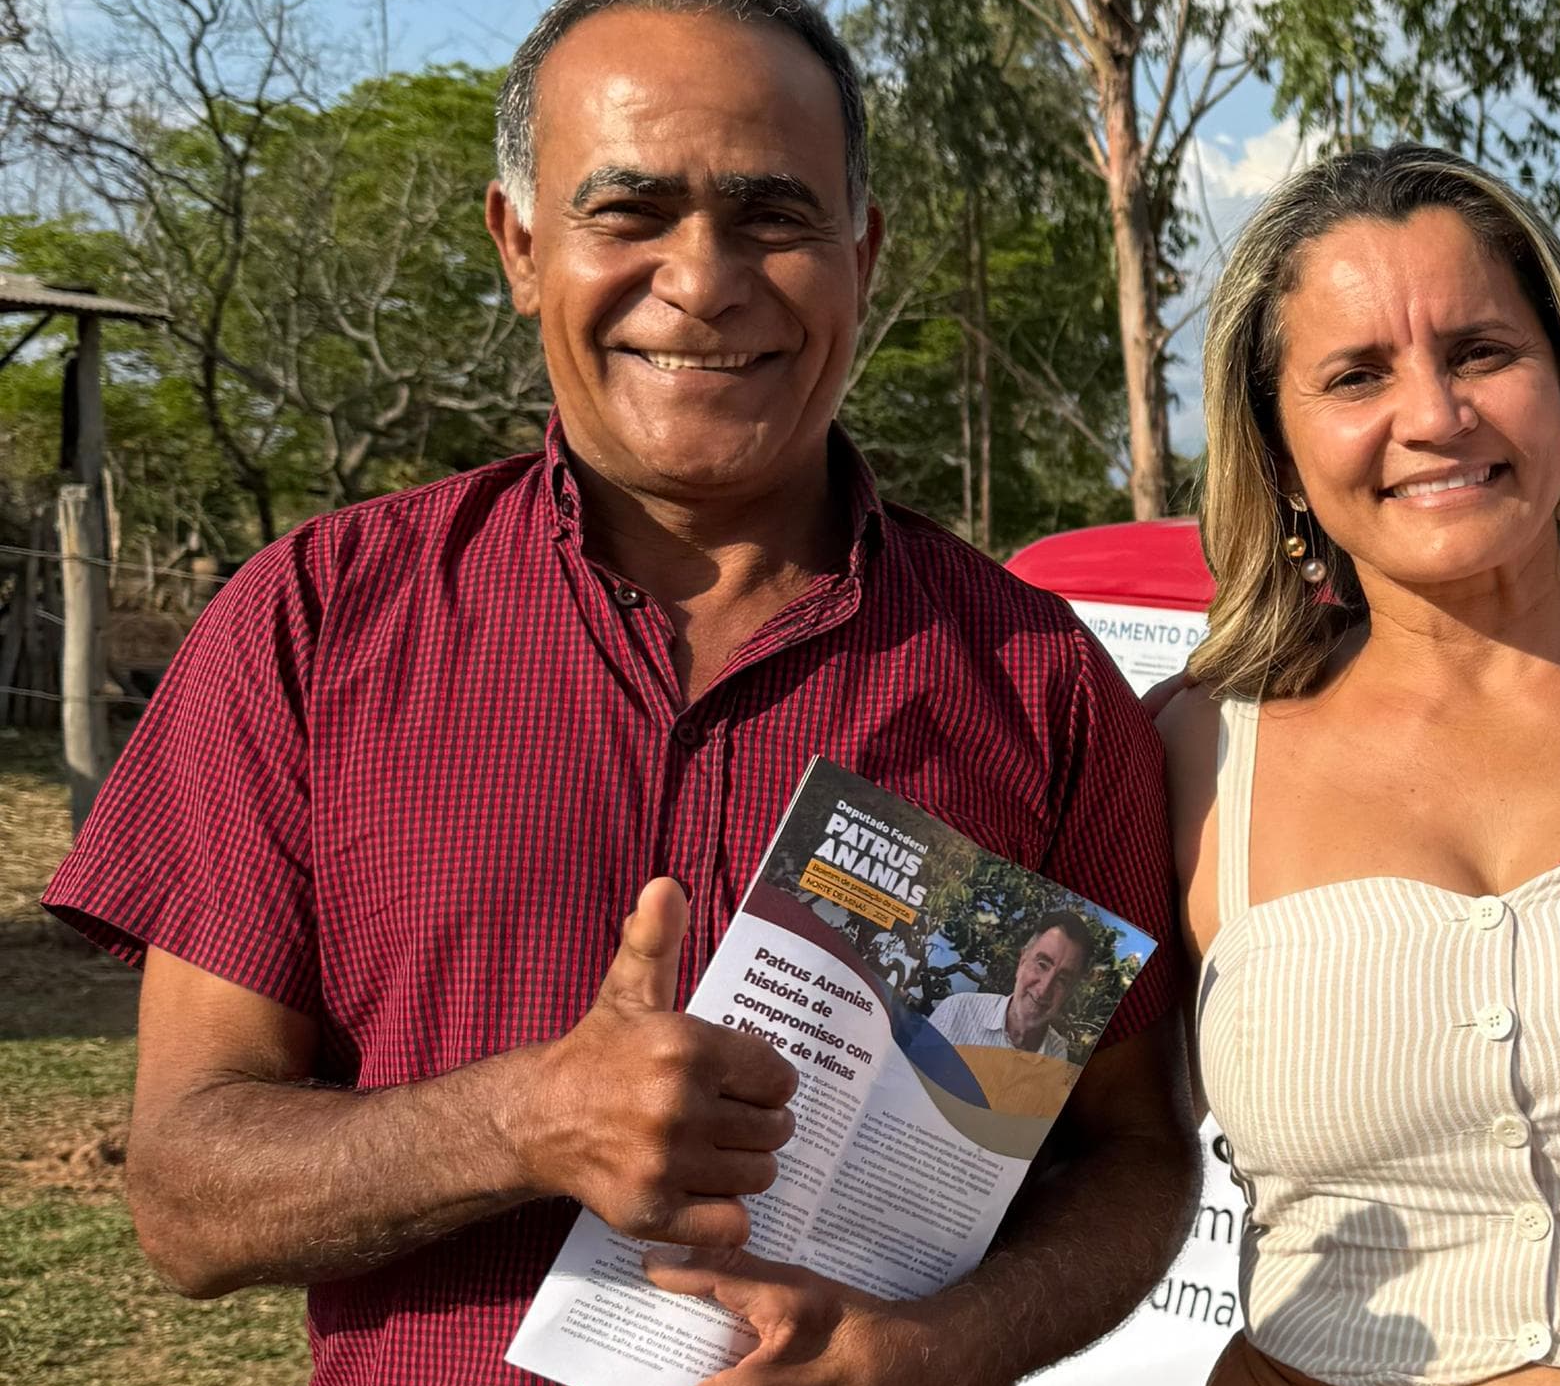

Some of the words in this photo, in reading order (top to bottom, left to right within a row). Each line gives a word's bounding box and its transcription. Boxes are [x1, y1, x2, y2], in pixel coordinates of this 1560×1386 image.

[1089, 618, 1181, 644] IPAMENTO
[823, 812, 924, 878] PATRUS
[834, 799, 891, 836] Deputado
[889, 827, 929, 855] Federal
[805, 877, 832, 895] NORTE
[813, 834, 929, 908] ANANIAS
[743, 966, 811, 1008] história
[809, 998, 835, 1019] de
[754, 946, 813, 983] Patrus
[810, 973, 879, 1015] Ananias,
[721, 1012, 736, 1027] o
[736, 1016, 789, 1049] Norte
[789, 1039, 814, 1060] de
[812, 1049, 859, 1081] Minas
[731, 988, 846, 1051] compromisso
[843, 1043, 873, 1065] com
